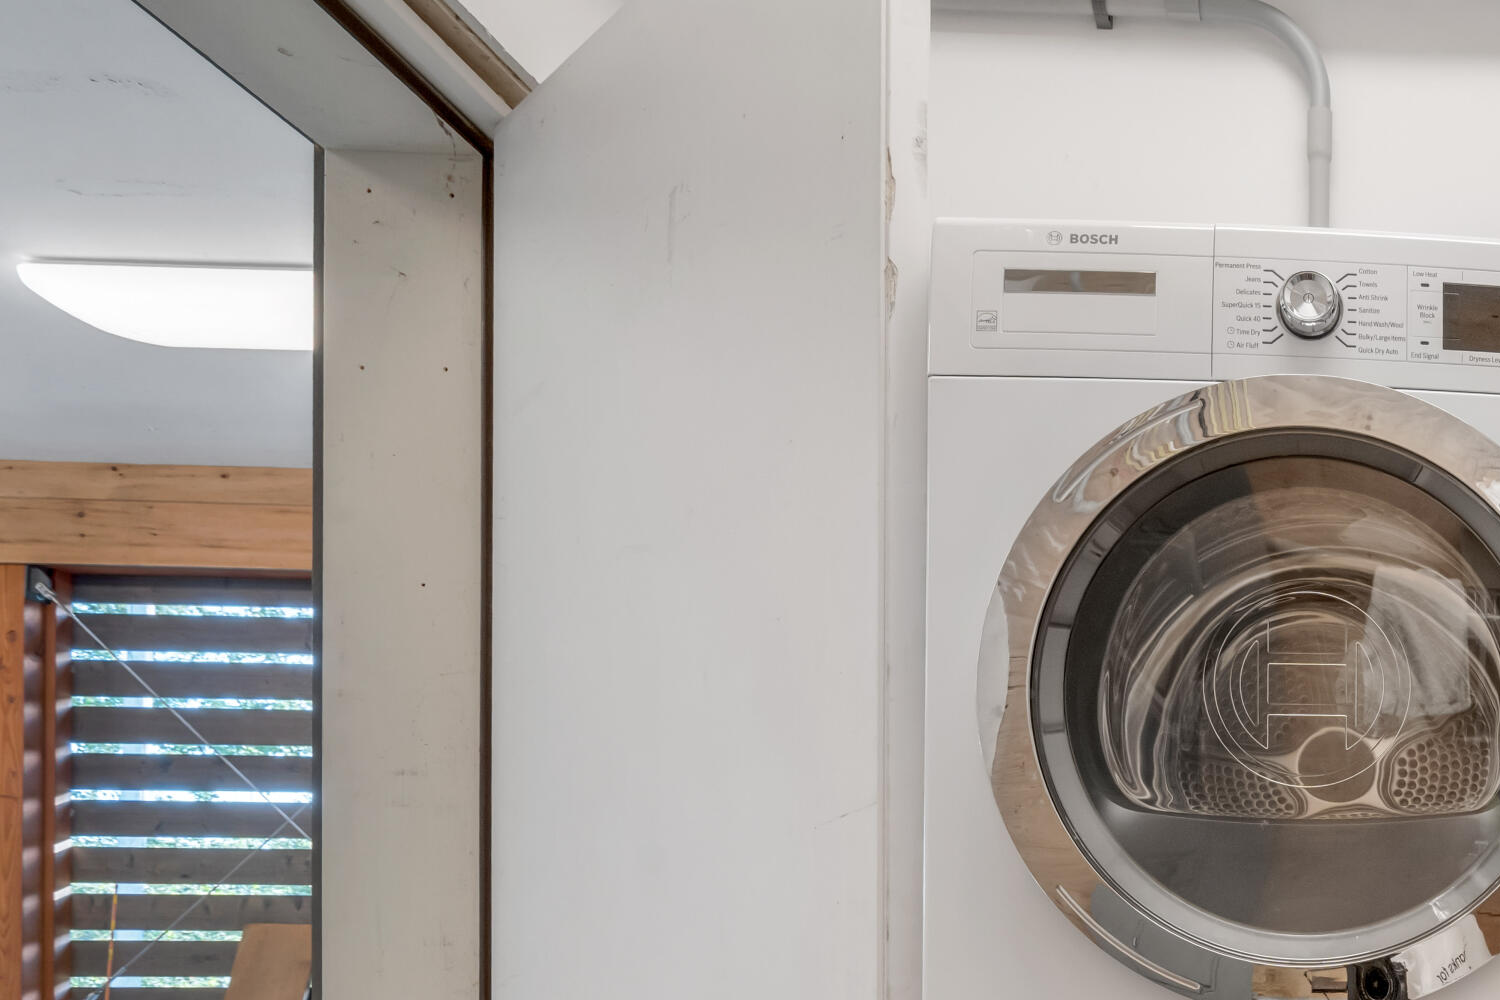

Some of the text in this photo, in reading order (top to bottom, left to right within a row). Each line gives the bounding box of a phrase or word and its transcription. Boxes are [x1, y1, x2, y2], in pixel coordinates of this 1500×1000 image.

[1070, 233, 1119, 245] BOSCH
[1221, 301, 1253, 309] SuperQuick
[1469, 355, 1490, 364] Dryness
